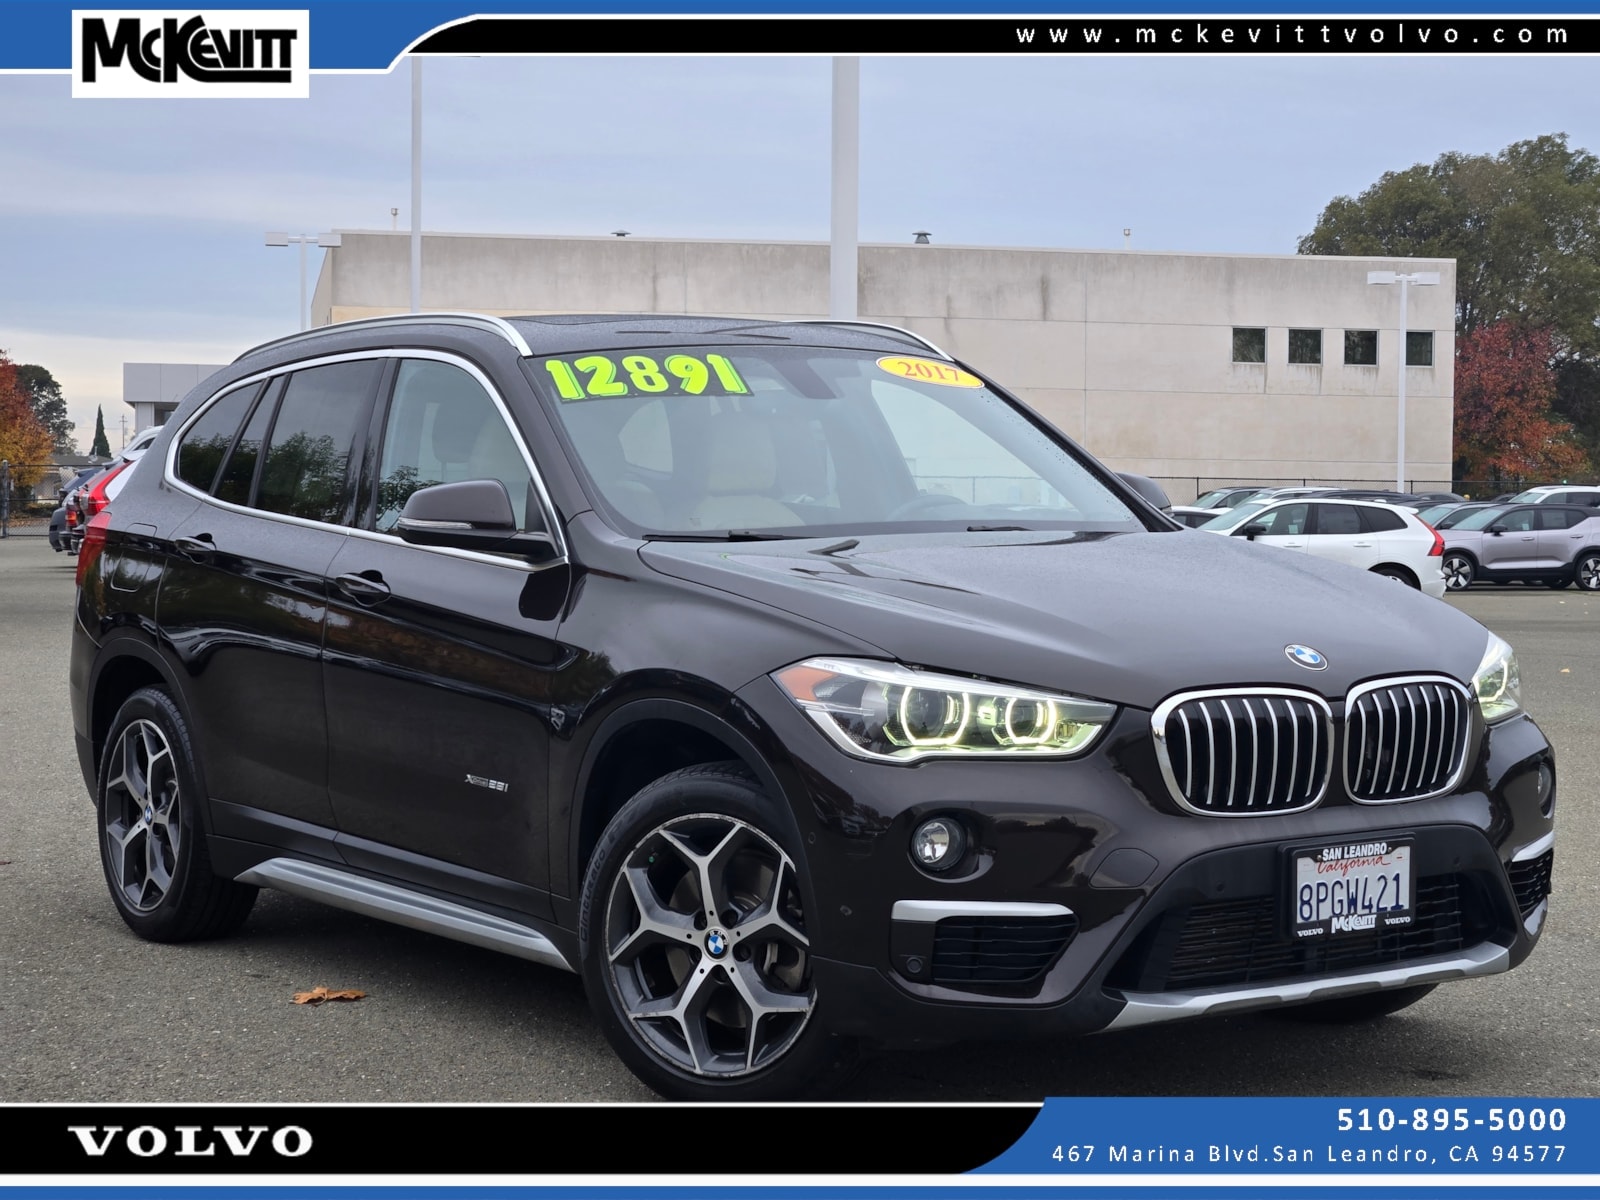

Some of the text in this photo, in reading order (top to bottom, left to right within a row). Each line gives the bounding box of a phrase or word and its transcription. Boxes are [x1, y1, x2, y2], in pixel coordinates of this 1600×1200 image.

[545, 353, 748, 400] 12891
[897, 361, 959, 382] 2017
[1322, 842, 1387, 862] SAN LEANDRO
[1317, 855, 1391, 877] California
[1299, 872, 1404, 922] 8PGW421
[1384, 916, 1411, 925] VOLVO
[1297, 928, 1324, 937] VOLVO
